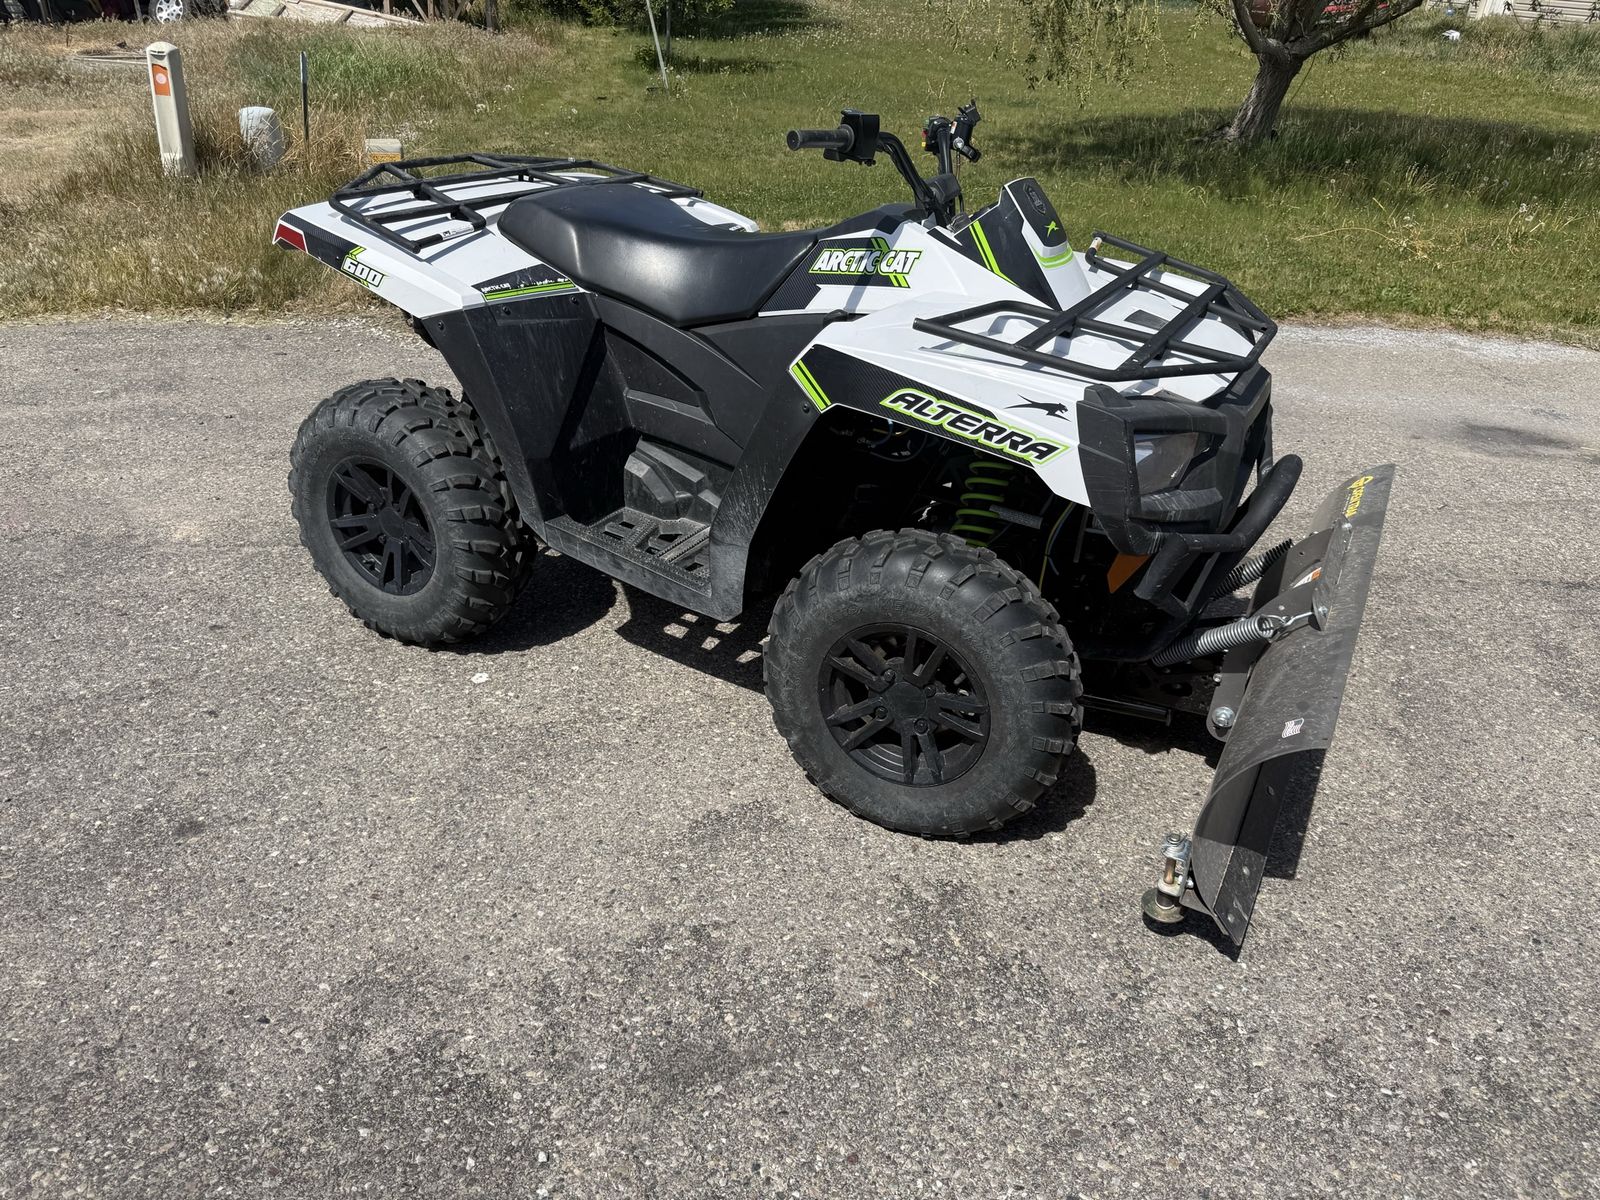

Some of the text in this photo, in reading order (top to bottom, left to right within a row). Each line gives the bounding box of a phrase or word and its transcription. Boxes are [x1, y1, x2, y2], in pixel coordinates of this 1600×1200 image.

[342, 256, 385, 288] 600
[811, 249, 922, 274] ARCTIC CAT
[887, 391, 1062, 462] ALTERRA
